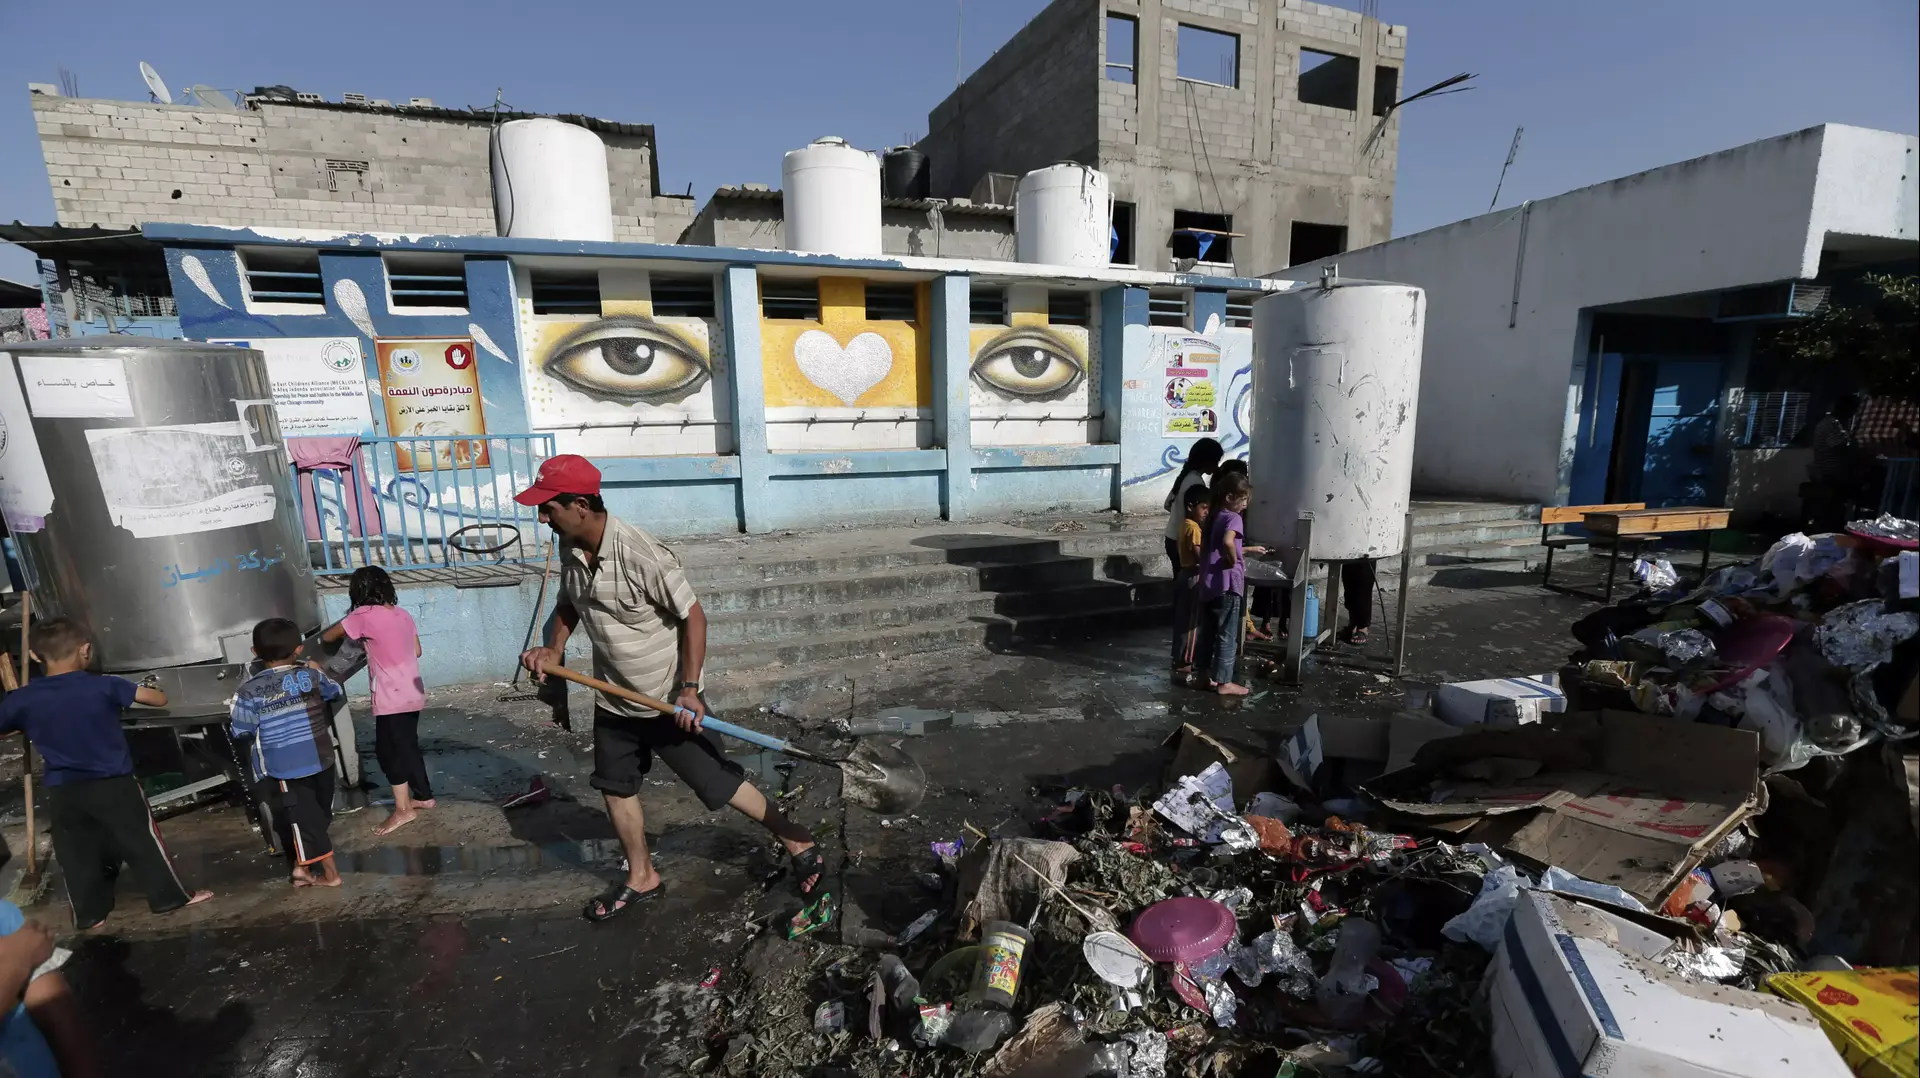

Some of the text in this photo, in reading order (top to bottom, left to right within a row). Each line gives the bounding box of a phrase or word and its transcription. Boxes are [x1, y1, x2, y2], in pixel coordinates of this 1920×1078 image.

[37, 378, 115, 389] خاص بالنساء
[389, 385, 472, 397] مبادرة صون النعمة
[282, 670, 312, 696] 46
[261, 700, 288, 713] STORM
